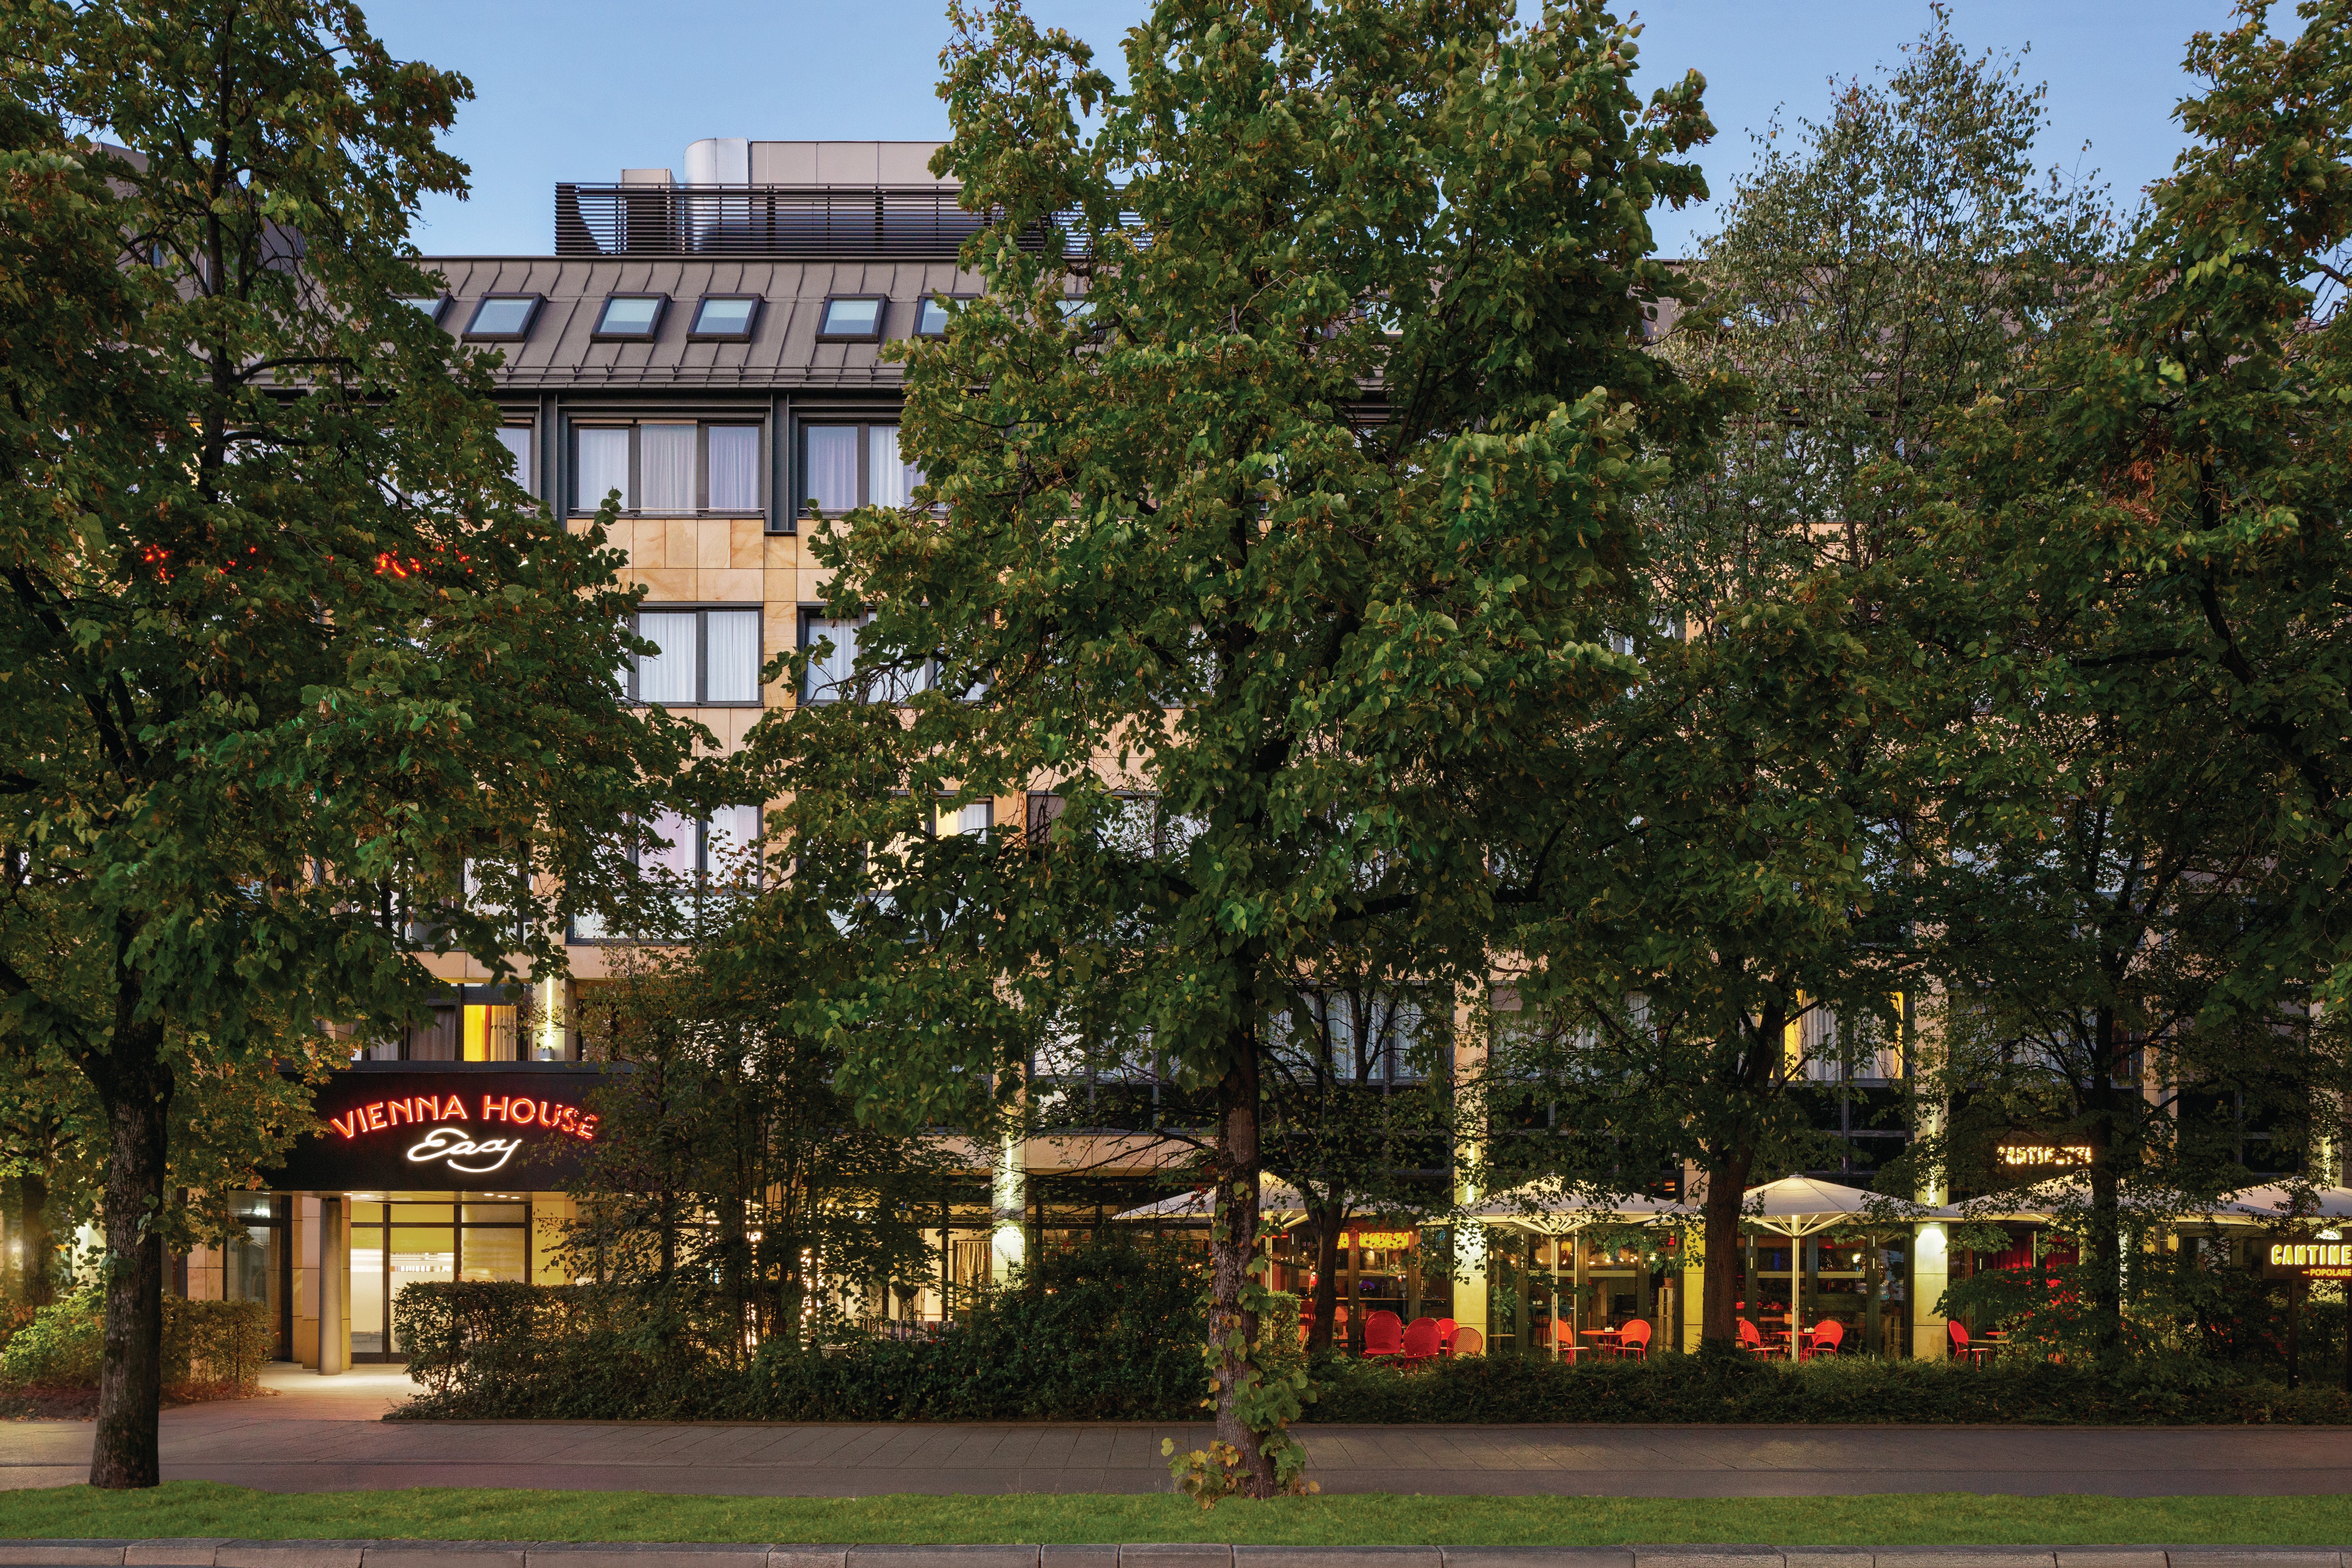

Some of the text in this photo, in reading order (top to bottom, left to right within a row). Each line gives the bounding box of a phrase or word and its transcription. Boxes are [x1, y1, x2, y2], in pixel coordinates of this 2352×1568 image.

[331, 1095, 599, 1139] VIENNA HOUSE
[408, 1128, 522, 1172] Easy
